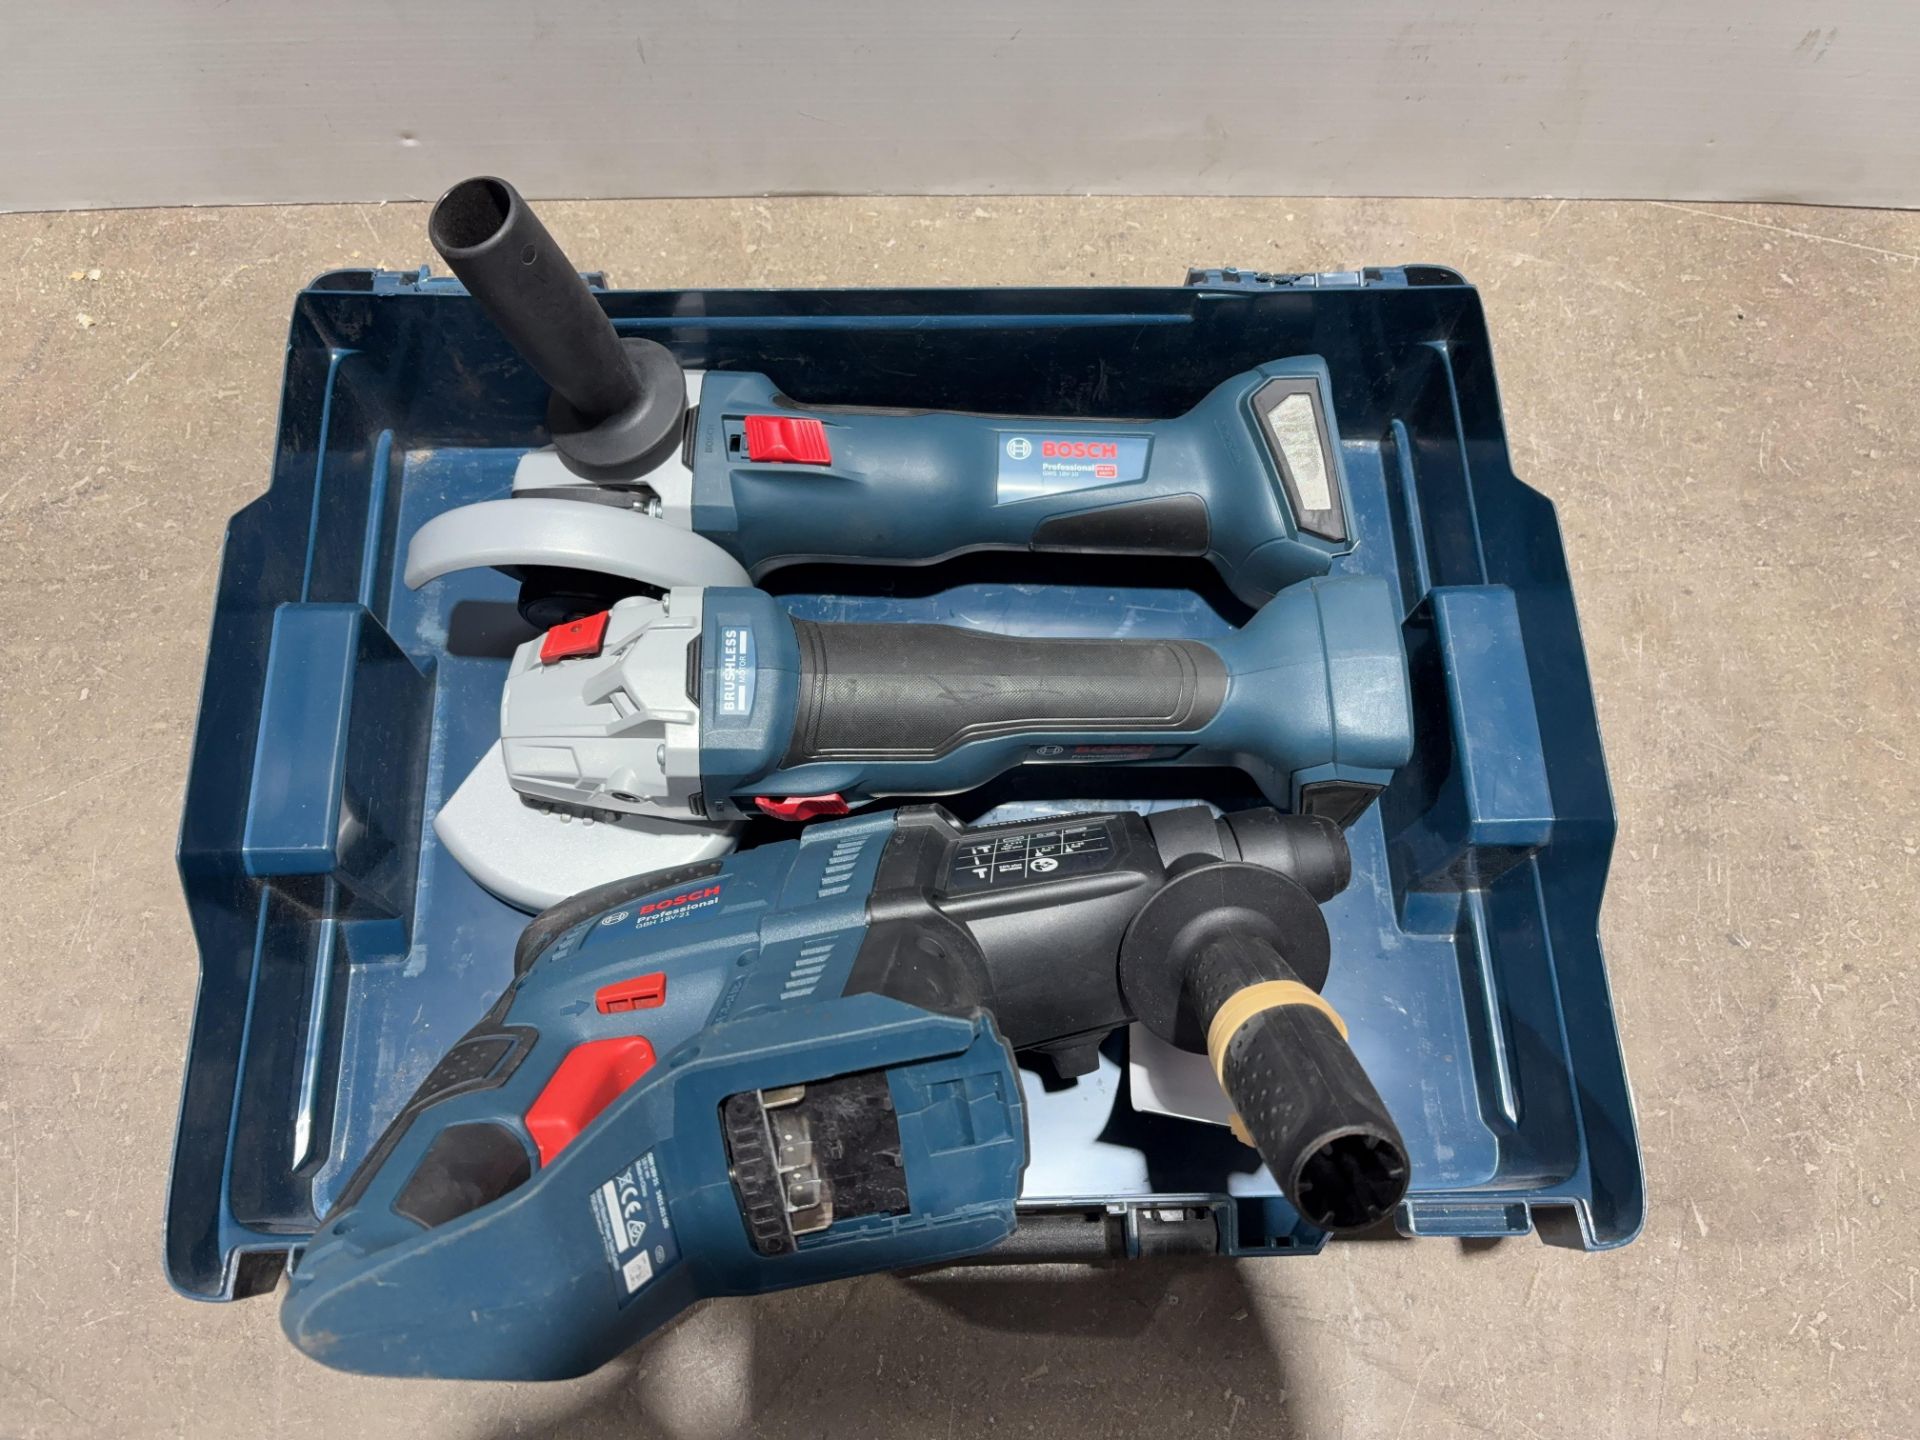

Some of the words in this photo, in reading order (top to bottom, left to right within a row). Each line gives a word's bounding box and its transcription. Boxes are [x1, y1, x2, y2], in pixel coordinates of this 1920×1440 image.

[1042, 441, 1117, 458] BOSCH
[1042, 463, 1095, 472] Professional
[723, 630, 737, 711] BRUSHLESS
[738, 655, 747, 683] MOTOR
[636, 897, 719, 924] Professional
[640, 885, 721, 915] BOSCH
[659, 911, 690, 924] 18V-21
